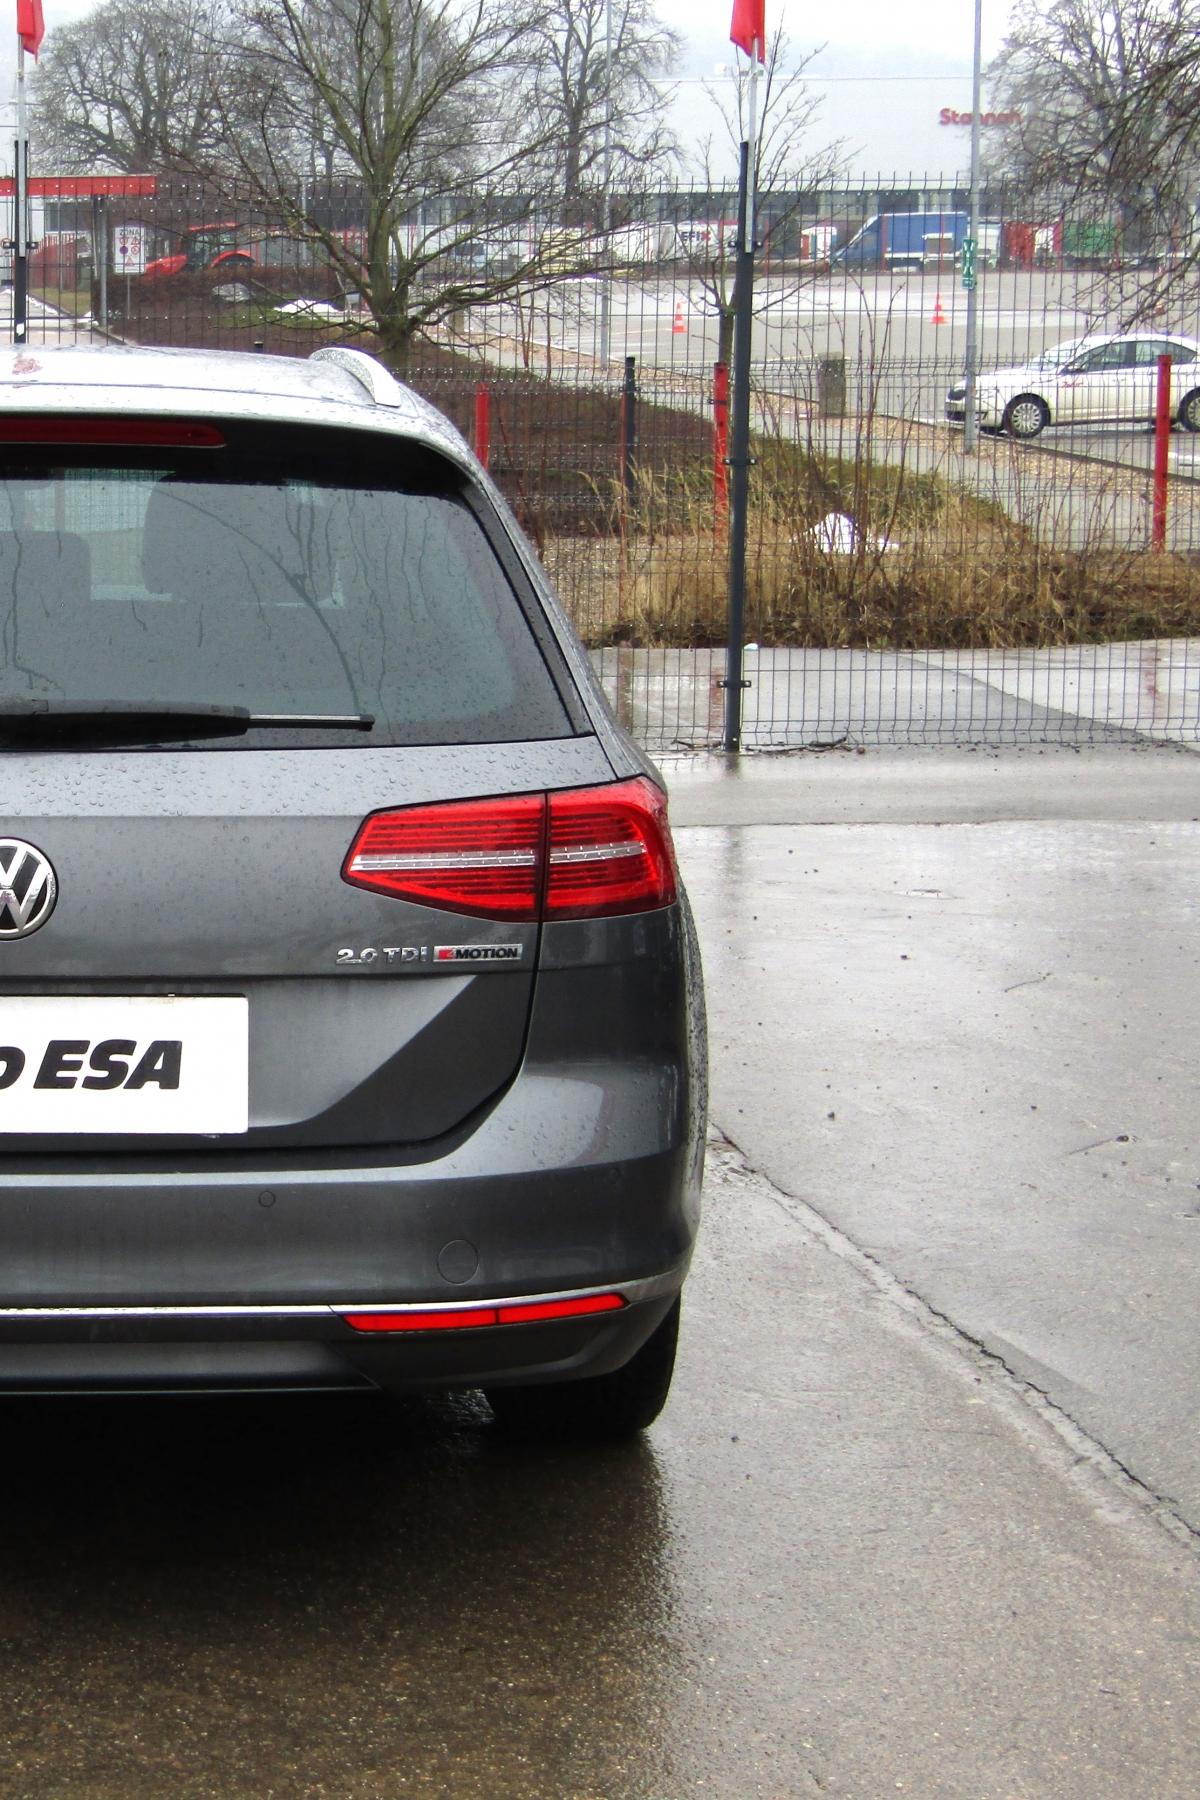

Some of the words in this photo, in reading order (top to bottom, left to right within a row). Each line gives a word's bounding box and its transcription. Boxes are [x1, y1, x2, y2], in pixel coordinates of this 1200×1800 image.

[336, 946, 379, 964] 2.0
[382, 946, 428, 963] TDI
[33, 1039, 182, 1090] ESA
